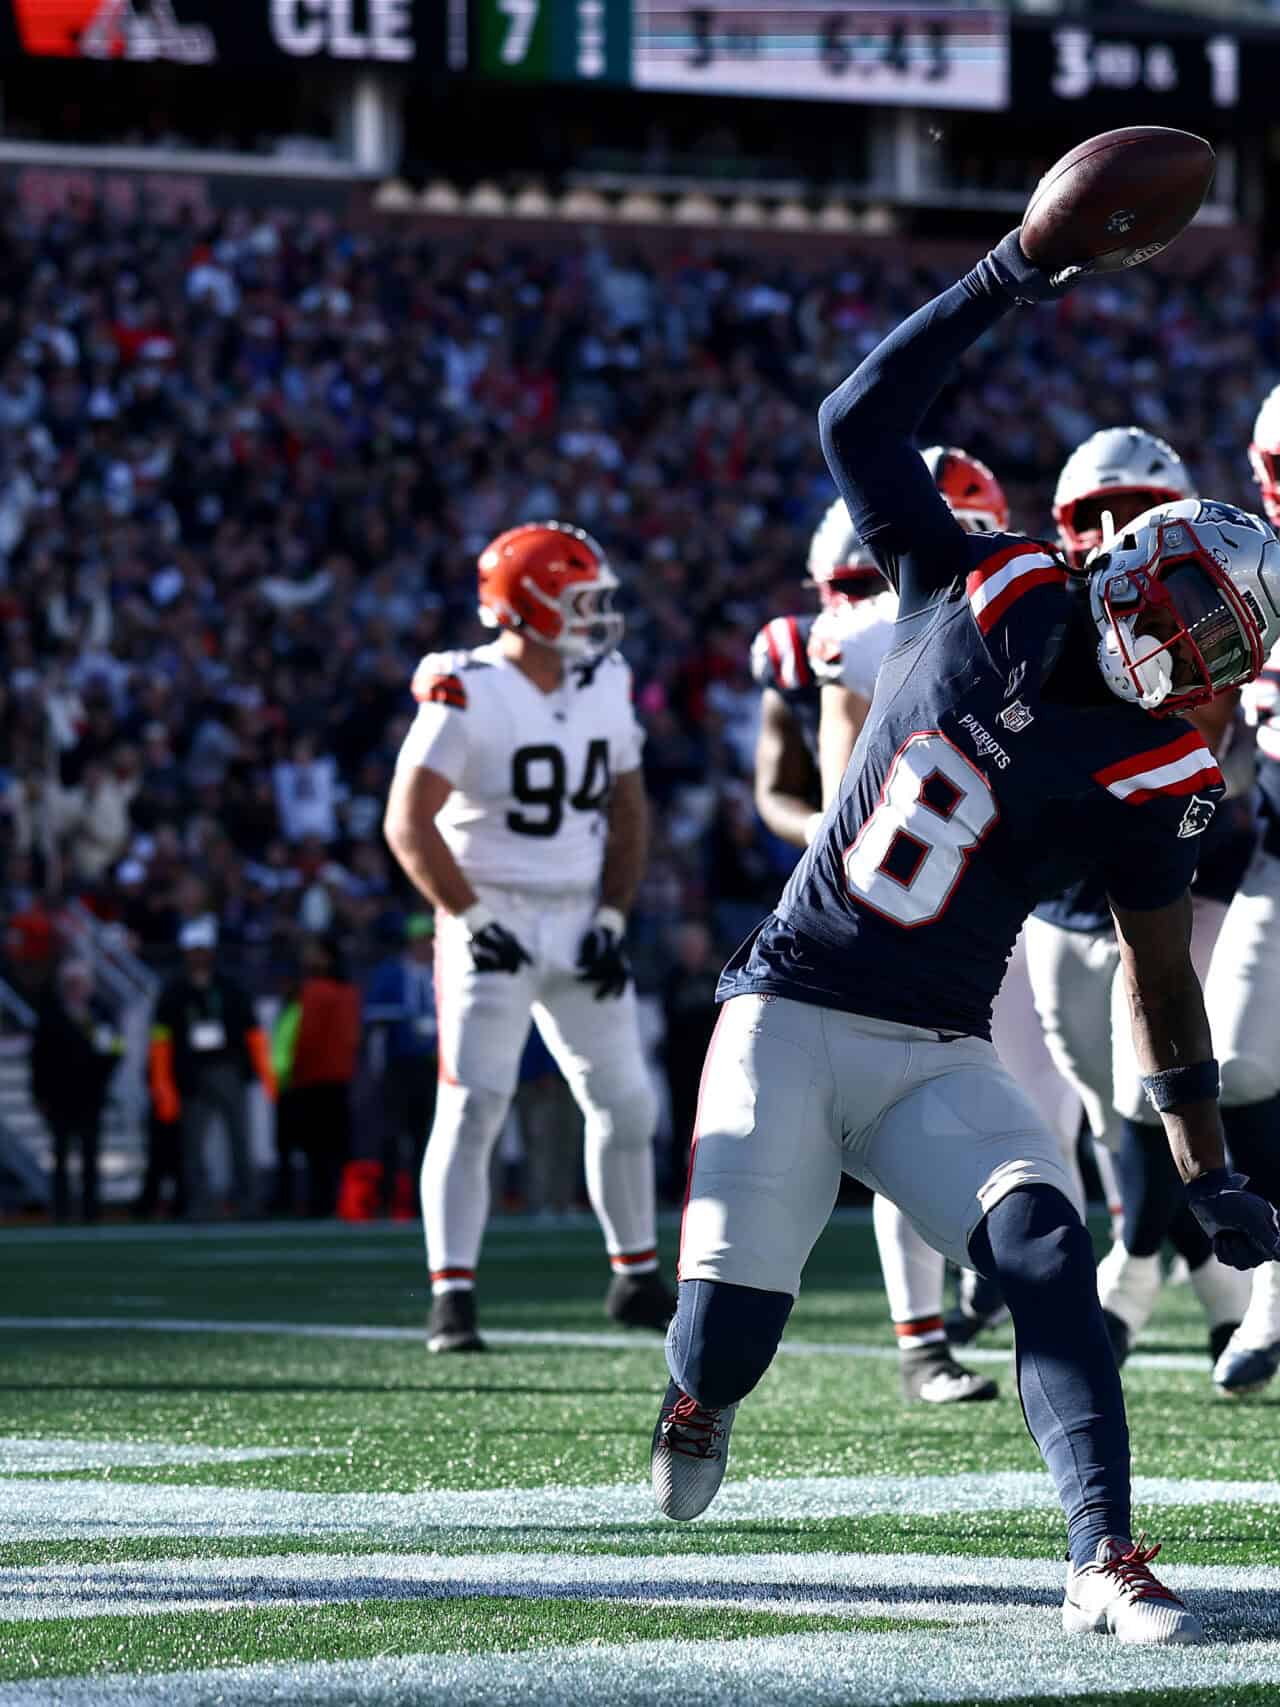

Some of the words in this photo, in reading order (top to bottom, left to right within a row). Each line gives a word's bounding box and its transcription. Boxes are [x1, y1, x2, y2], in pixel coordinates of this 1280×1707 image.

[270, 0, 415, 62] CLE
[497, 0, 539, 65] 7
[1207, 36, 1240, 107] 1
[957, 713, 1011, 770] PATRIOTS
[505, 738, 612, 838] 94
[842, 729, 999, 930] 8
